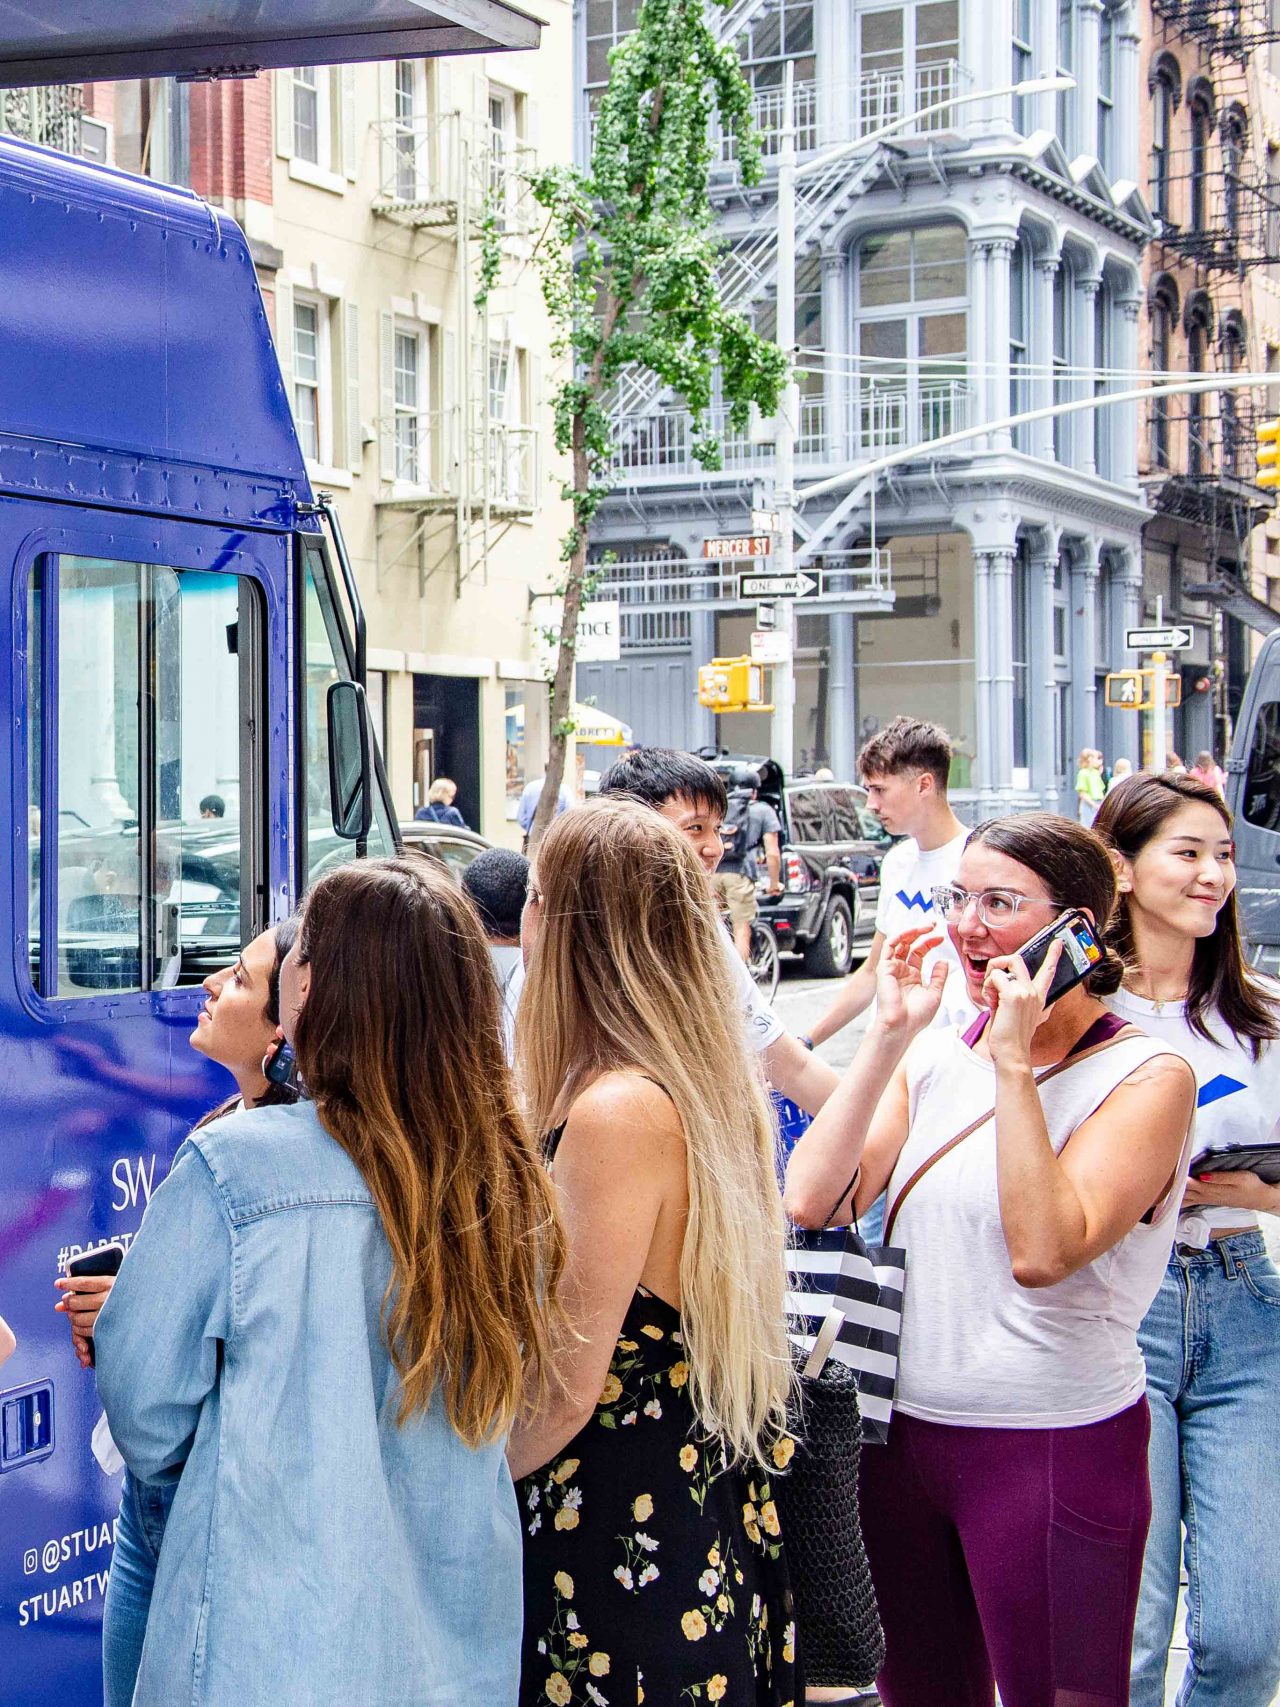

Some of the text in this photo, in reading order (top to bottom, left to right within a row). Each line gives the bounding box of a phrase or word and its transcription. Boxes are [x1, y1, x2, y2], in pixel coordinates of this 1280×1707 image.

[708, 538, 768, 557] MERCER ST
[750, 580, 808, 592] ONE WAY
[541, 621, 612, 640] SOTICE
[112, 1154, 156, 1211] SW
